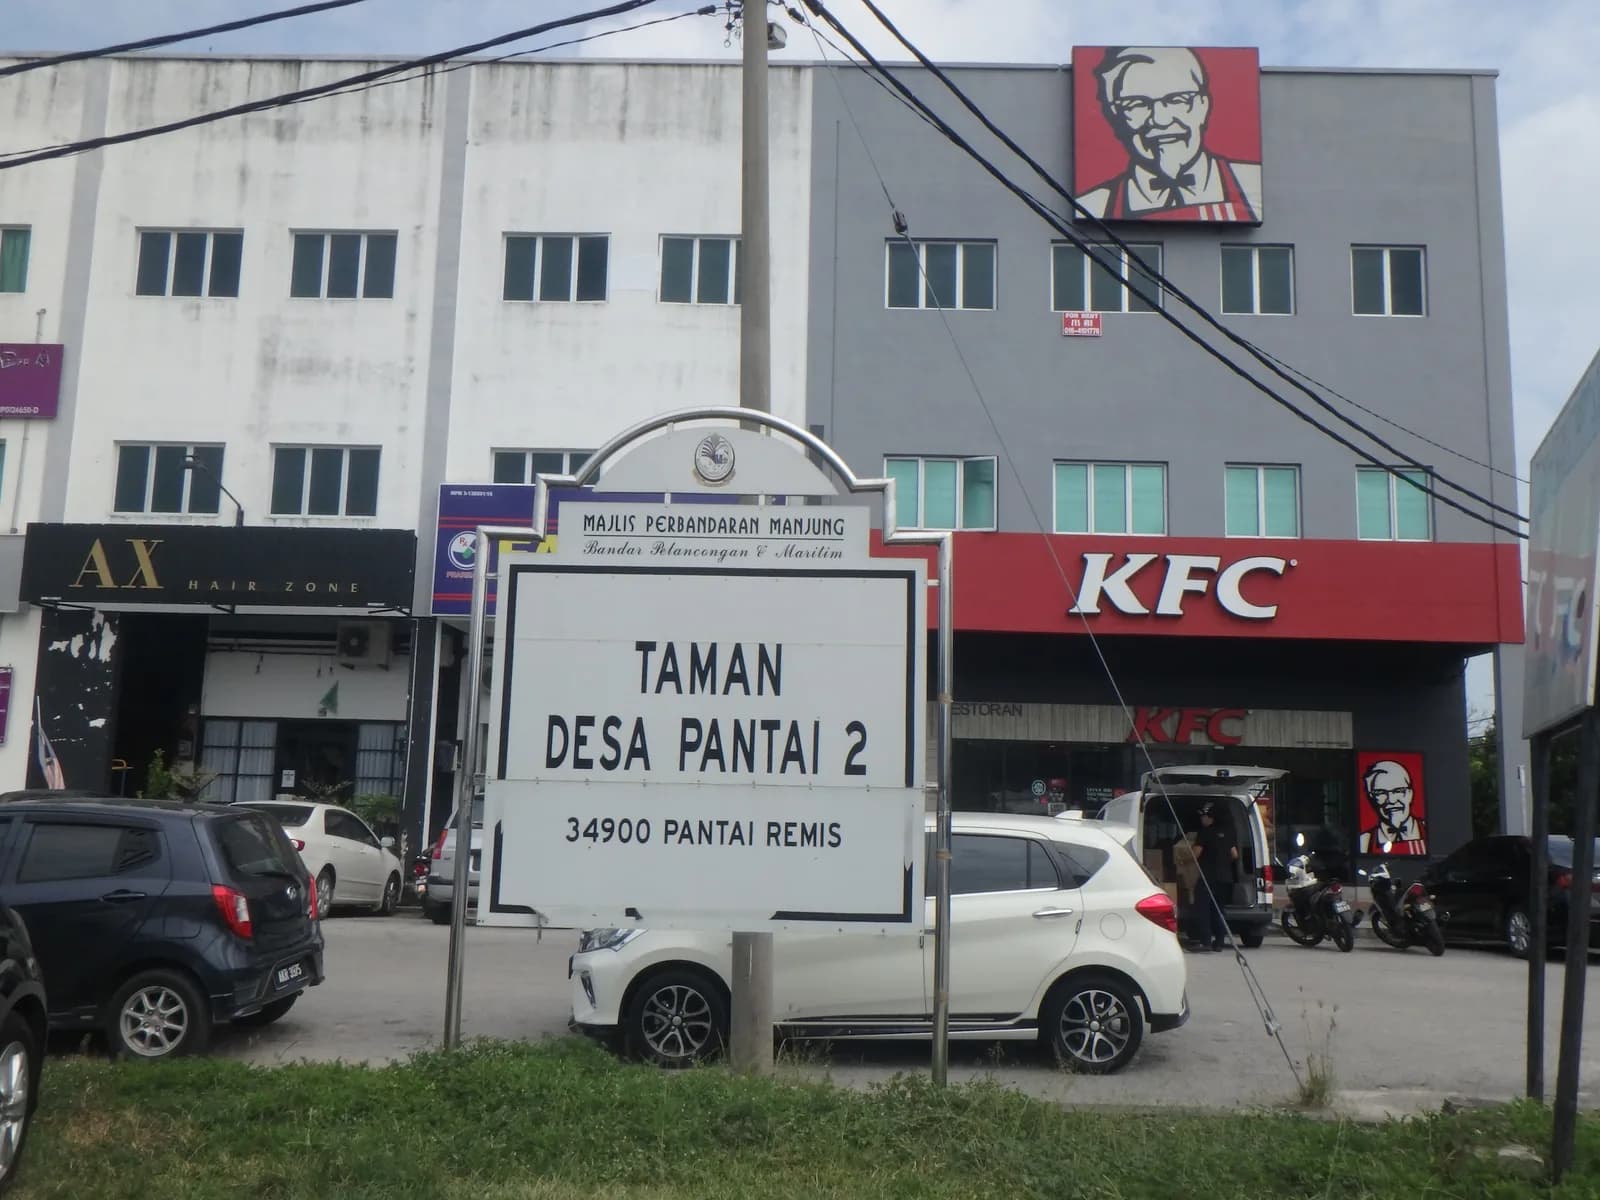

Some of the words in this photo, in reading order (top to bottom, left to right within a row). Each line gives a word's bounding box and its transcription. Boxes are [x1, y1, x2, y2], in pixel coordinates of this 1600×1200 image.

[583, 514, 636, 533] MAJLIS
[646, 515, 760, 535] PERBANDARAN
[769, 518, 845, 536] MANJUNG
[68, 538, 164, 589] AX
[188, 580, 257, 592] HAIR
[285, 582, 360, 594] ZONE
[583, 540, 643, 556] Bandar
[650, 541, 749, 562] Pelancongan
[775, 544, 844, 560] Maritim
[1068, 552, 1286, 619] KFC
[635, 640, 783, 697] TAMAN
[951, 703, 1023, 717] ESTORAN
[1126, 706, 1248, 745] KFC
[545, 714, 652, 771] DESA
[678, 717, 821, 775] PANTAI
[843, 720, 868, 776] 2
[565, 816, 651, 844] 34900
[663, 819, 754, 846] PANTAI
[766, 822, 843, 848] REMIS
